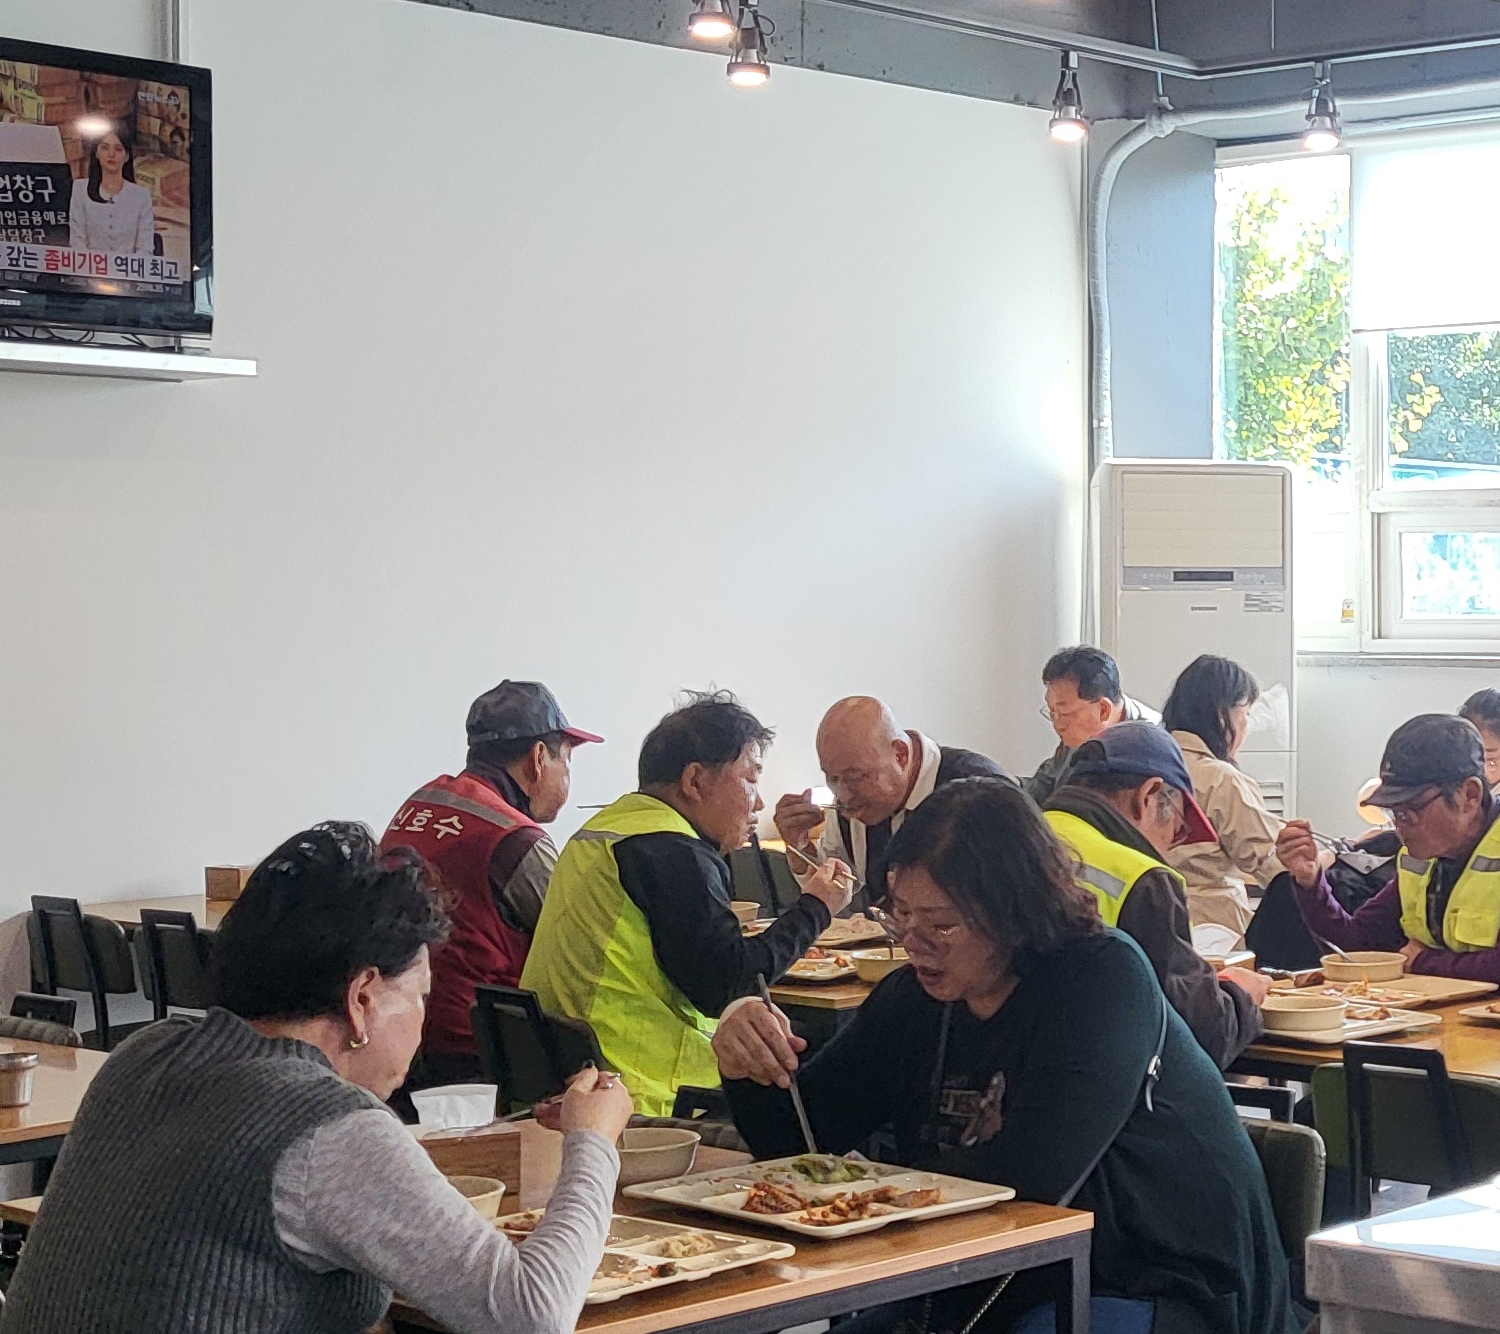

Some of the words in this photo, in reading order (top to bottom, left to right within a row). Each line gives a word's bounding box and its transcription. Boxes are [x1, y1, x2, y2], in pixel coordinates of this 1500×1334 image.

[44, 249, 108, 275] 좀비기업
[114, 255, 145, 278] 역대
[149, 258, 180, 280] 최고
